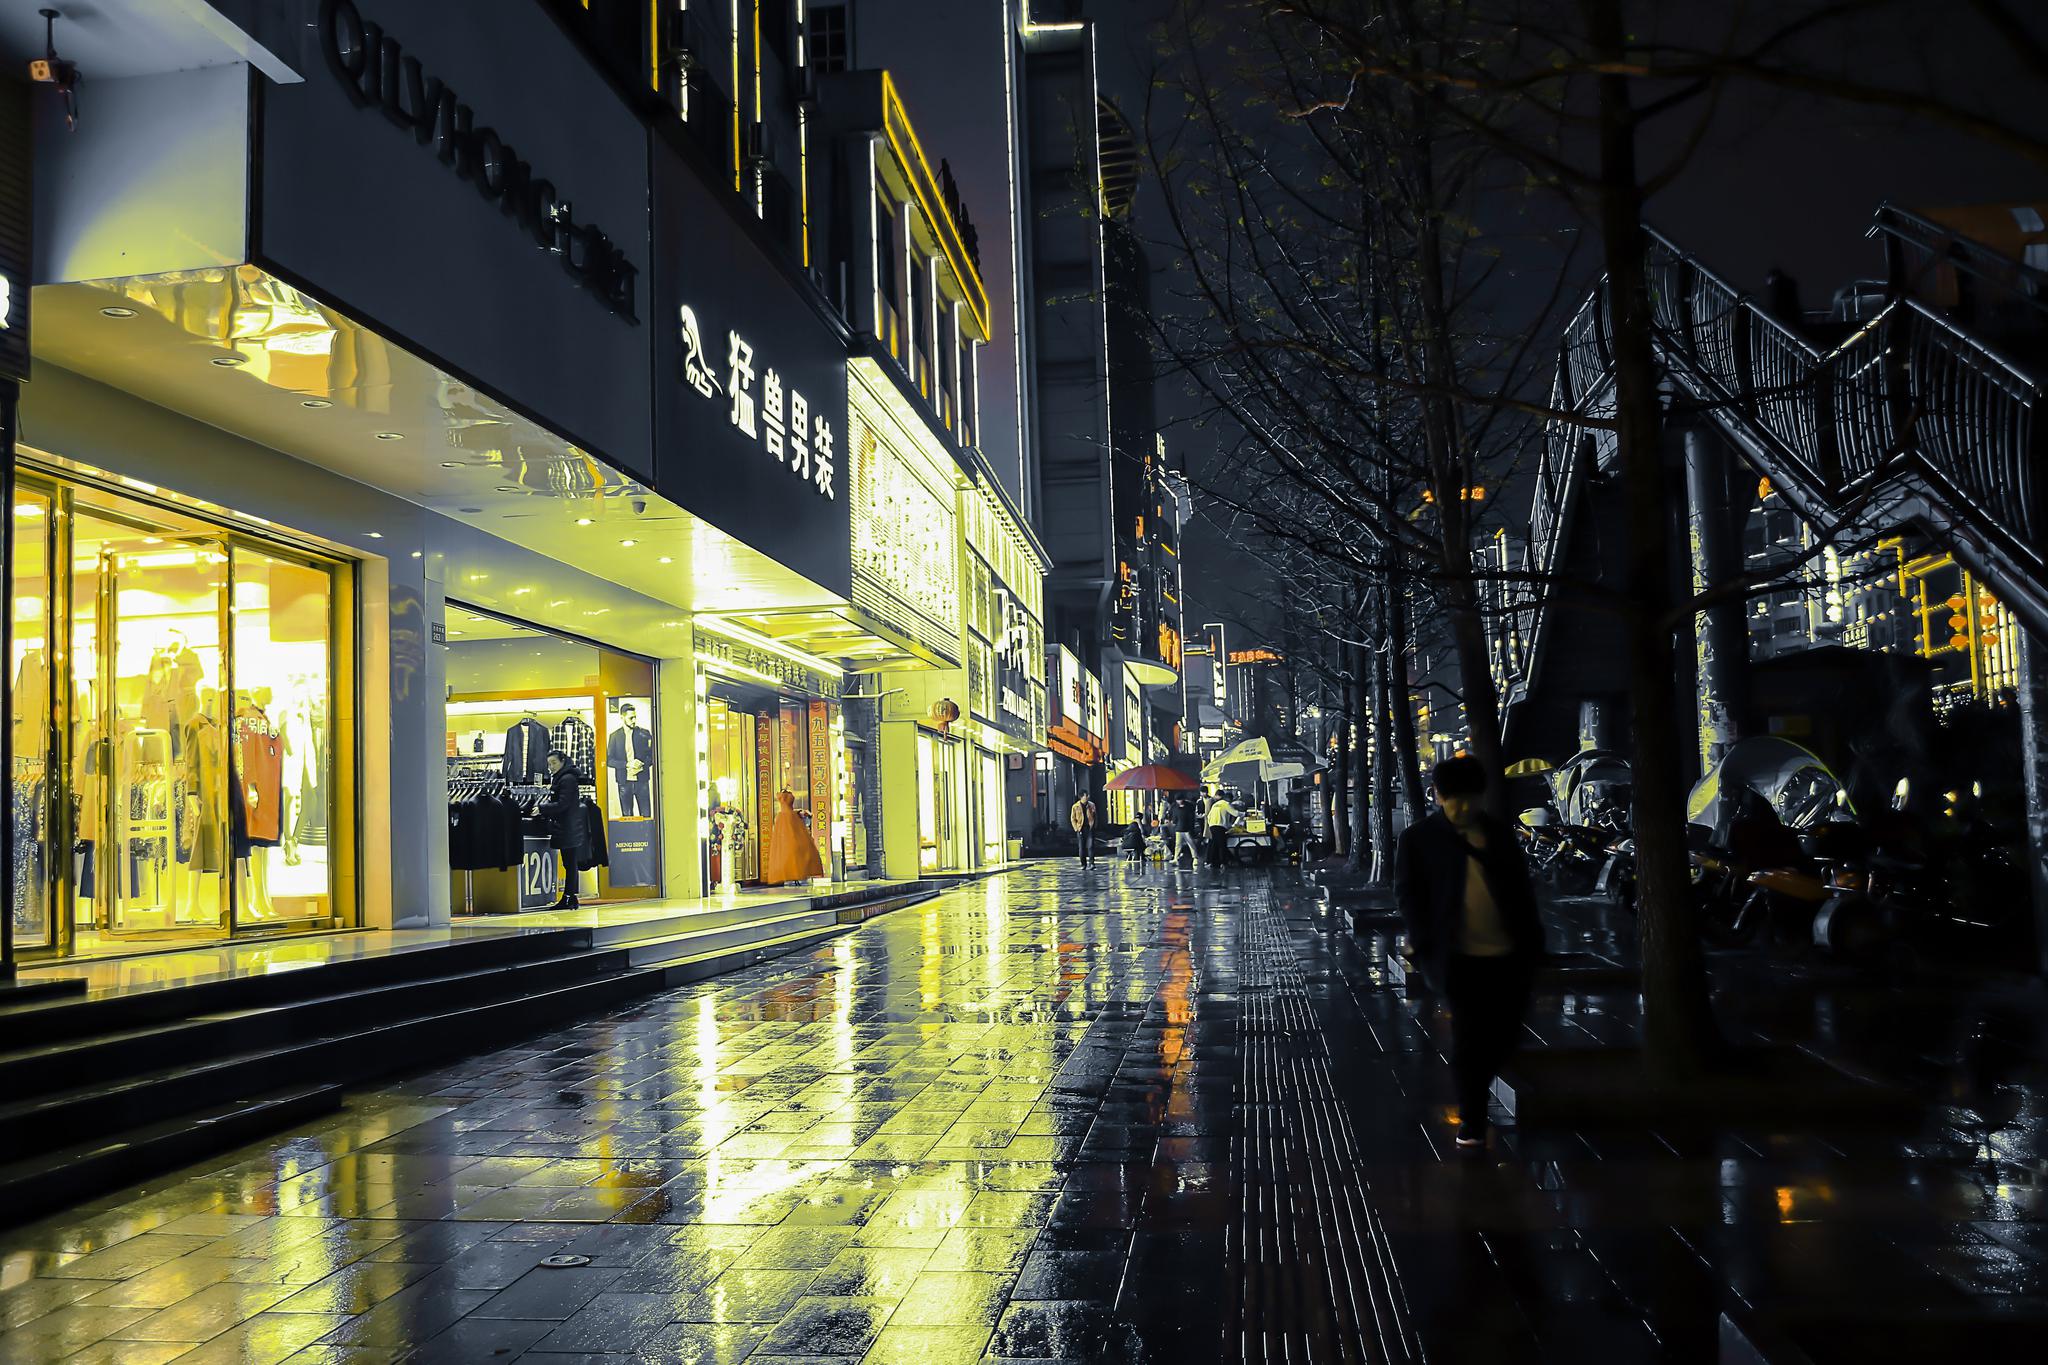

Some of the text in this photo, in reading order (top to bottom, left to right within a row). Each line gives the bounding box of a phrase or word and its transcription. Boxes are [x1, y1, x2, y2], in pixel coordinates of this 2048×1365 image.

[729, 328, 835, 501] 猛兽男装
[811, 716, 828, 797] 九五至尊金
[522, 851, 553, 896] 120
